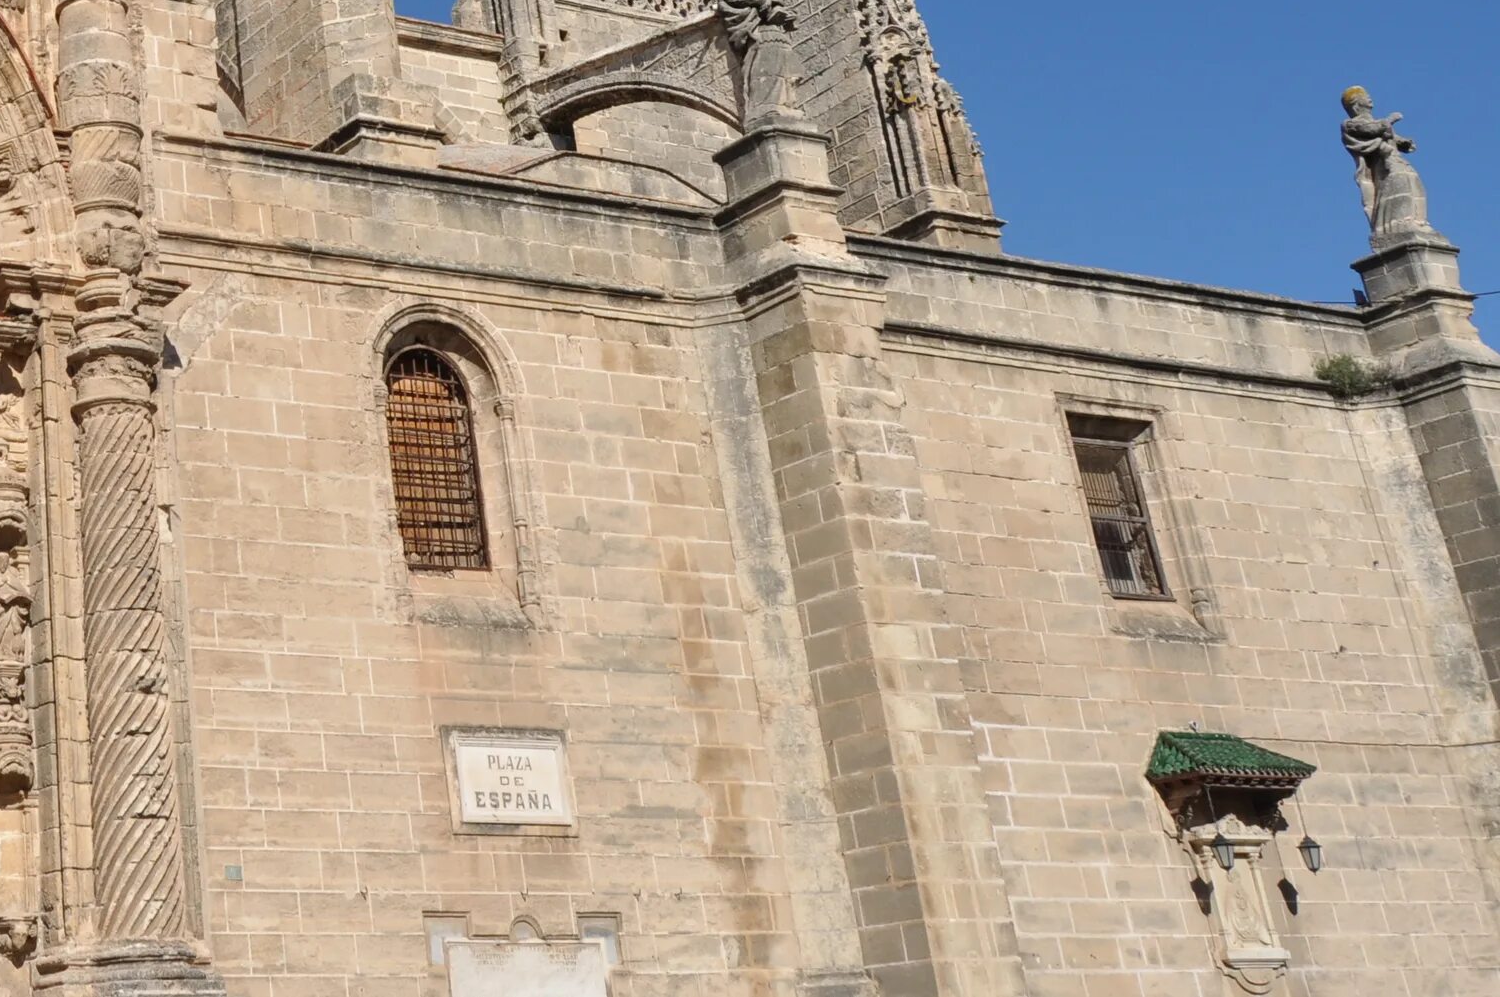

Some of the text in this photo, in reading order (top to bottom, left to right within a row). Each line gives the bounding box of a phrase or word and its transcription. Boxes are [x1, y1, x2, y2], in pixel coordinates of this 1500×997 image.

[488, 755, 532, 771] PLAZA
[500, 776, 524, 786] DE
[475, 790, 552, 809] ESPAÑA
